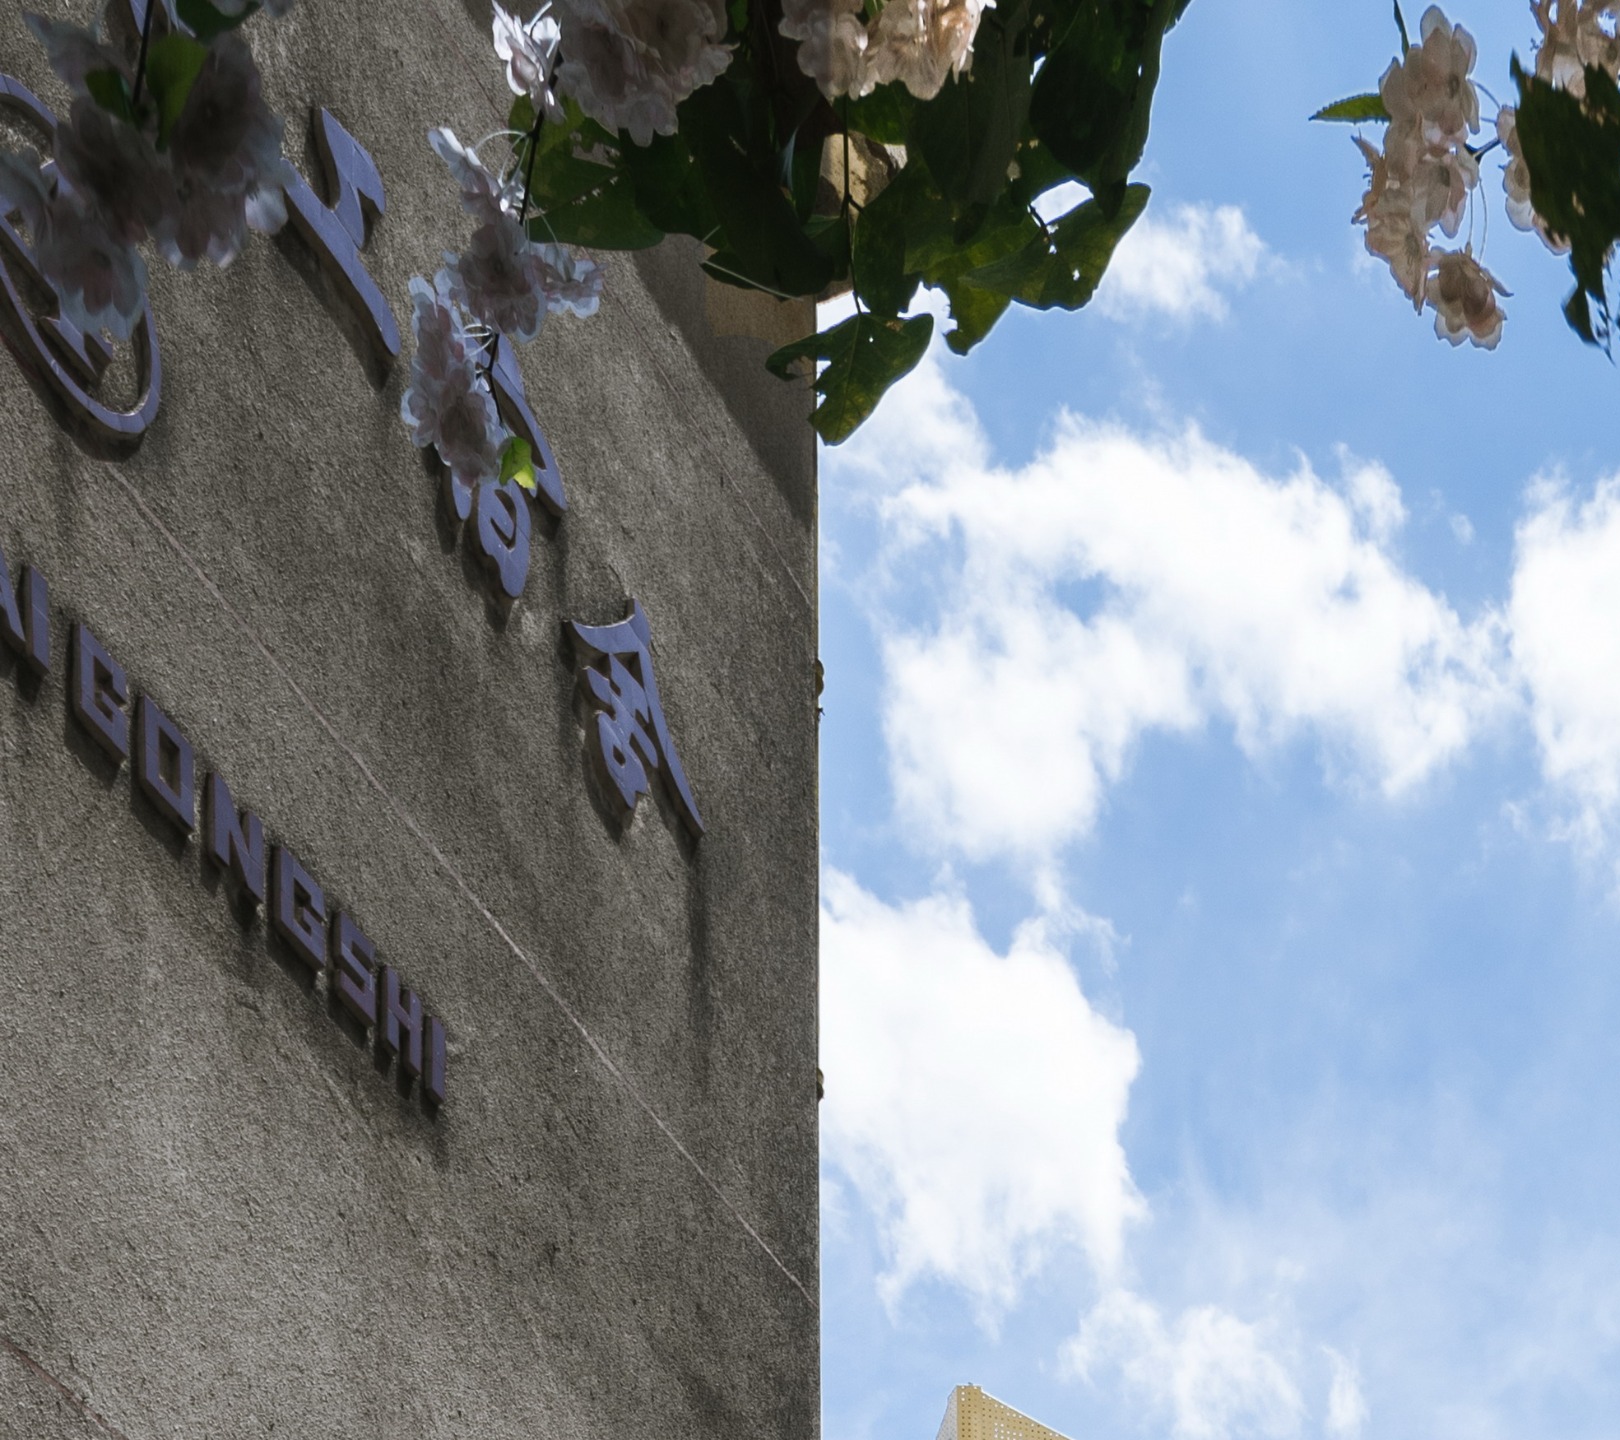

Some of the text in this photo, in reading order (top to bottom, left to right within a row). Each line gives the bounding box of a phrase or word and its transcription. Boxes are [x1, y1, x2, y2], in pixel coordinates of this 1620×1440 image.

[130, 0, 704, 835] 工宿舍
[77, 622, 446, 1104] GONGSHI
